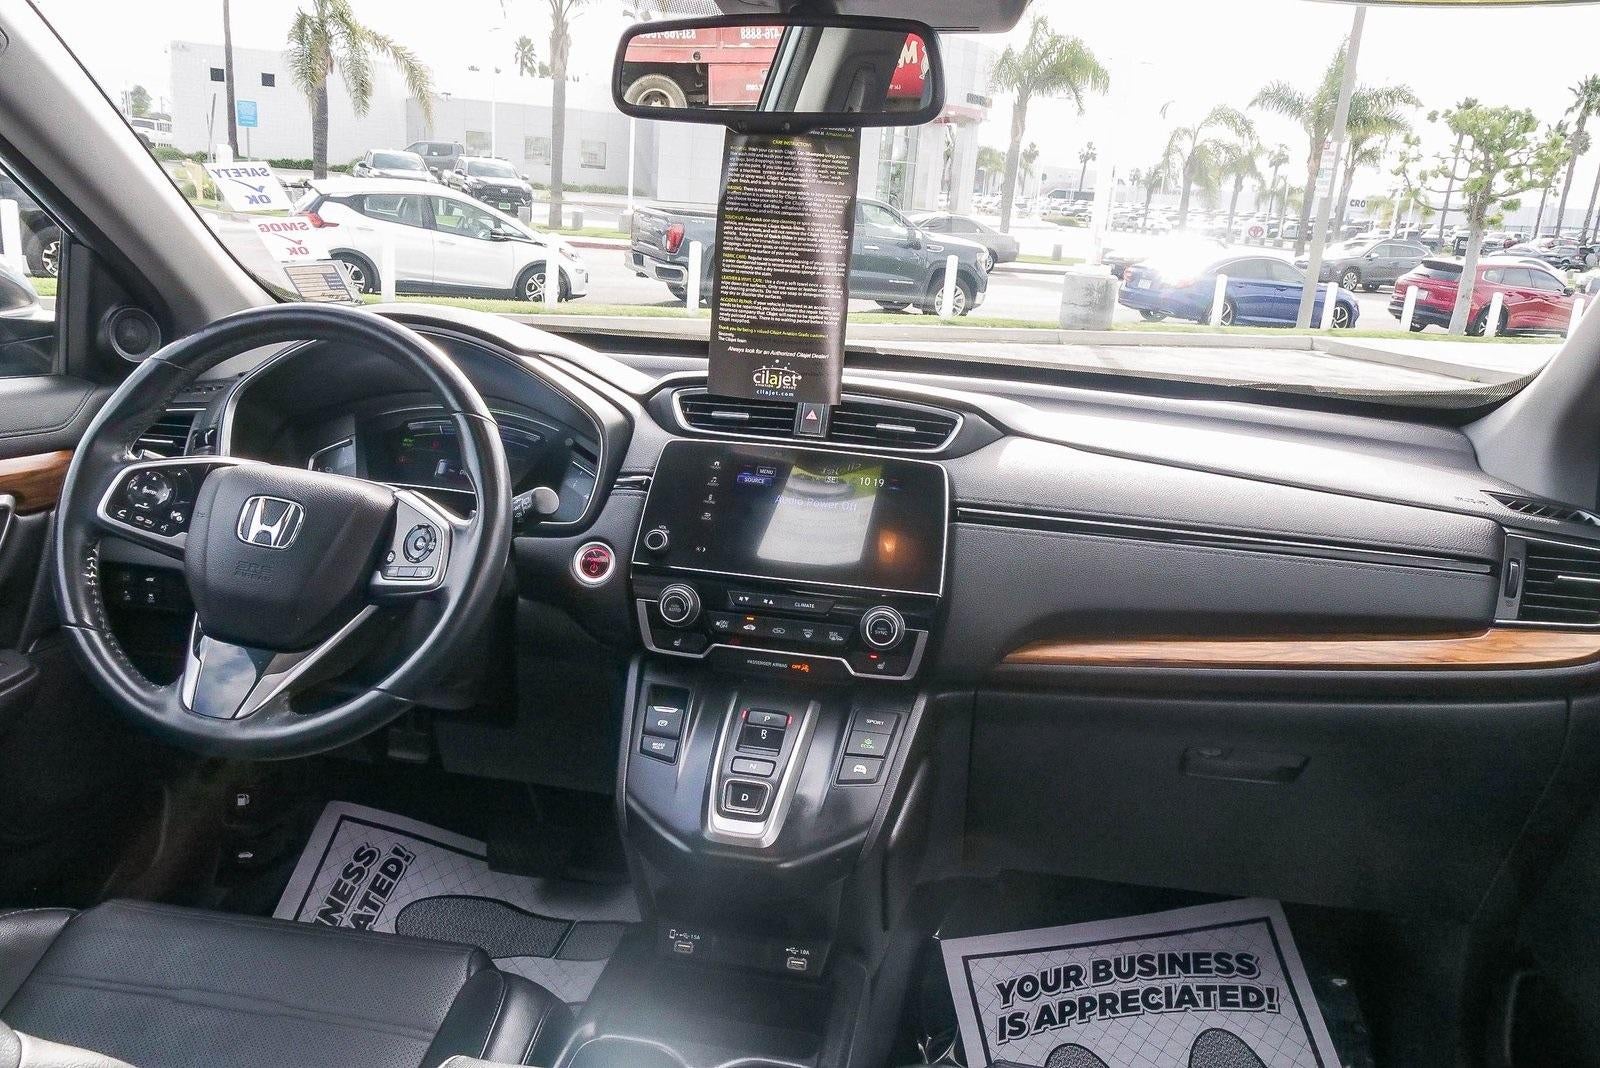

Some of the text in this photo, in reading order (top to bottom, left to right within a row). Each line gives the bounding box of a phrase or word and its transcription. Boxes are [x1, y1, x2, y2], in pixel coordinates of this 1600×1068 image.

[1350, 199, 1367, 208] CRO
[753, 370, 798, 388] cilajet
[756, 389, 794, 397] cilajet.com
[774, 495, 857, 512] Audio Power Off
[348, 843, 416, 929] ATED!
[997, 951, 1260, 1007] YOUR BUSINESS
[997, 984, 1279, 1045] IS APPRECIATED!
